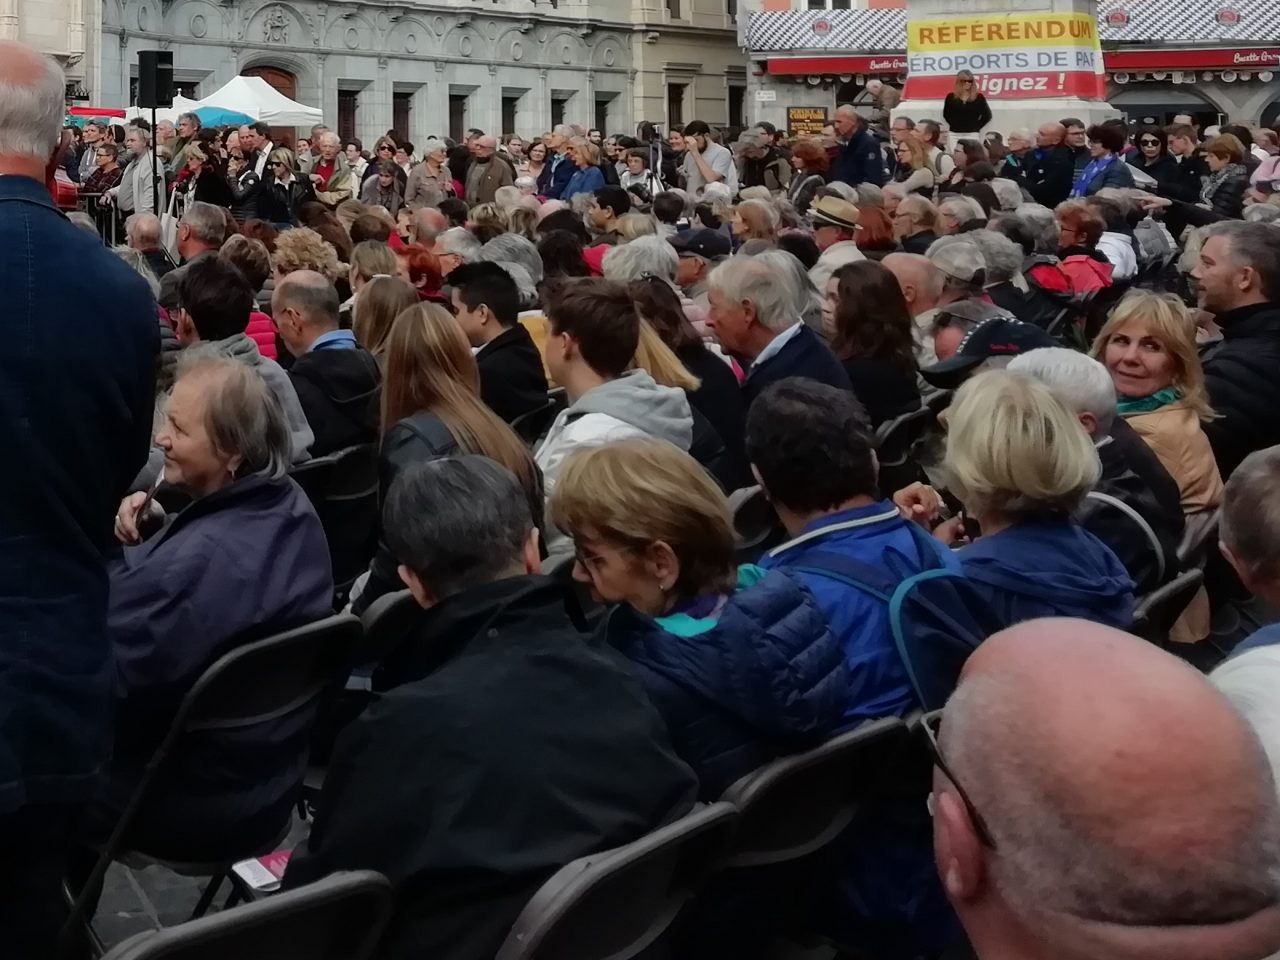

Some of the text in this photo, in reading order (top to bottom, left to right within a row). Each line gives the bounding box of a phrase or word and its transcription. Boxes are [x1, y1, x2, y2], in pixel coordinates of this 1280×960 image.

[919, 18, 1091, 45] RÉFÉRENDUM
[1037, 52, 1068, 67] DE
[1055, 73, 1066, 90] !
